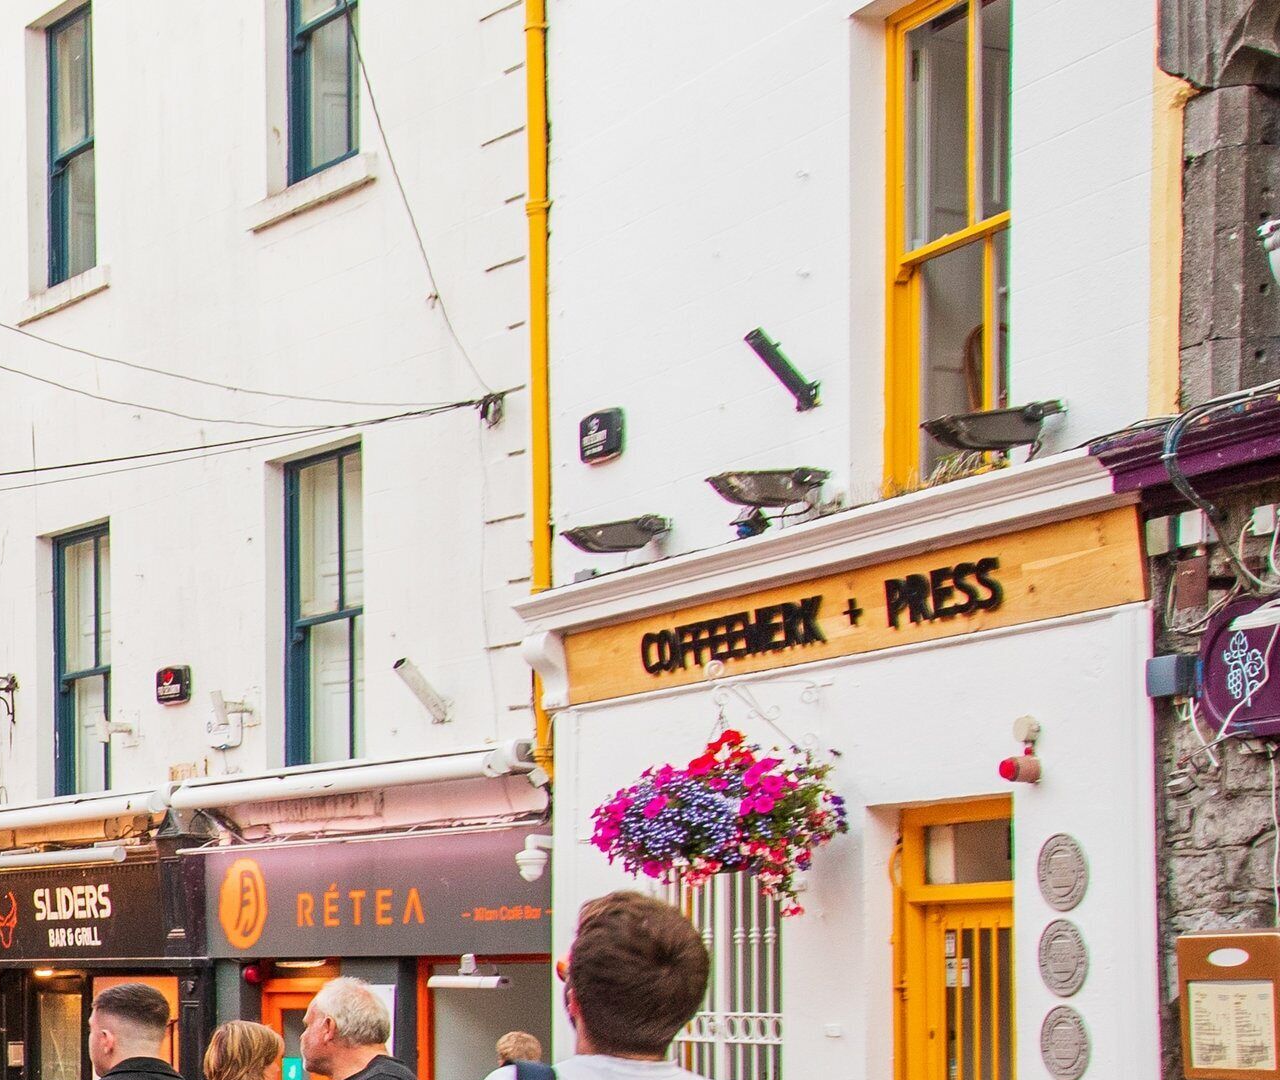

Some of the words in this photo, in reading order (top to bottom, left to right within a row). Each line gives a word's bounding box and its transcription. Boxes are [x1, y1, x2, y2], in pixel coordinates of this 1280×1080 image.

[884, 557, 1005, 630] PRESS
[34, 884, 111, 920] SLIDERS
[297, 883, 425, 927] RÉTEA
[48, 928, 66, 947] BAR
[74, 926, 102, 947] GRILL
